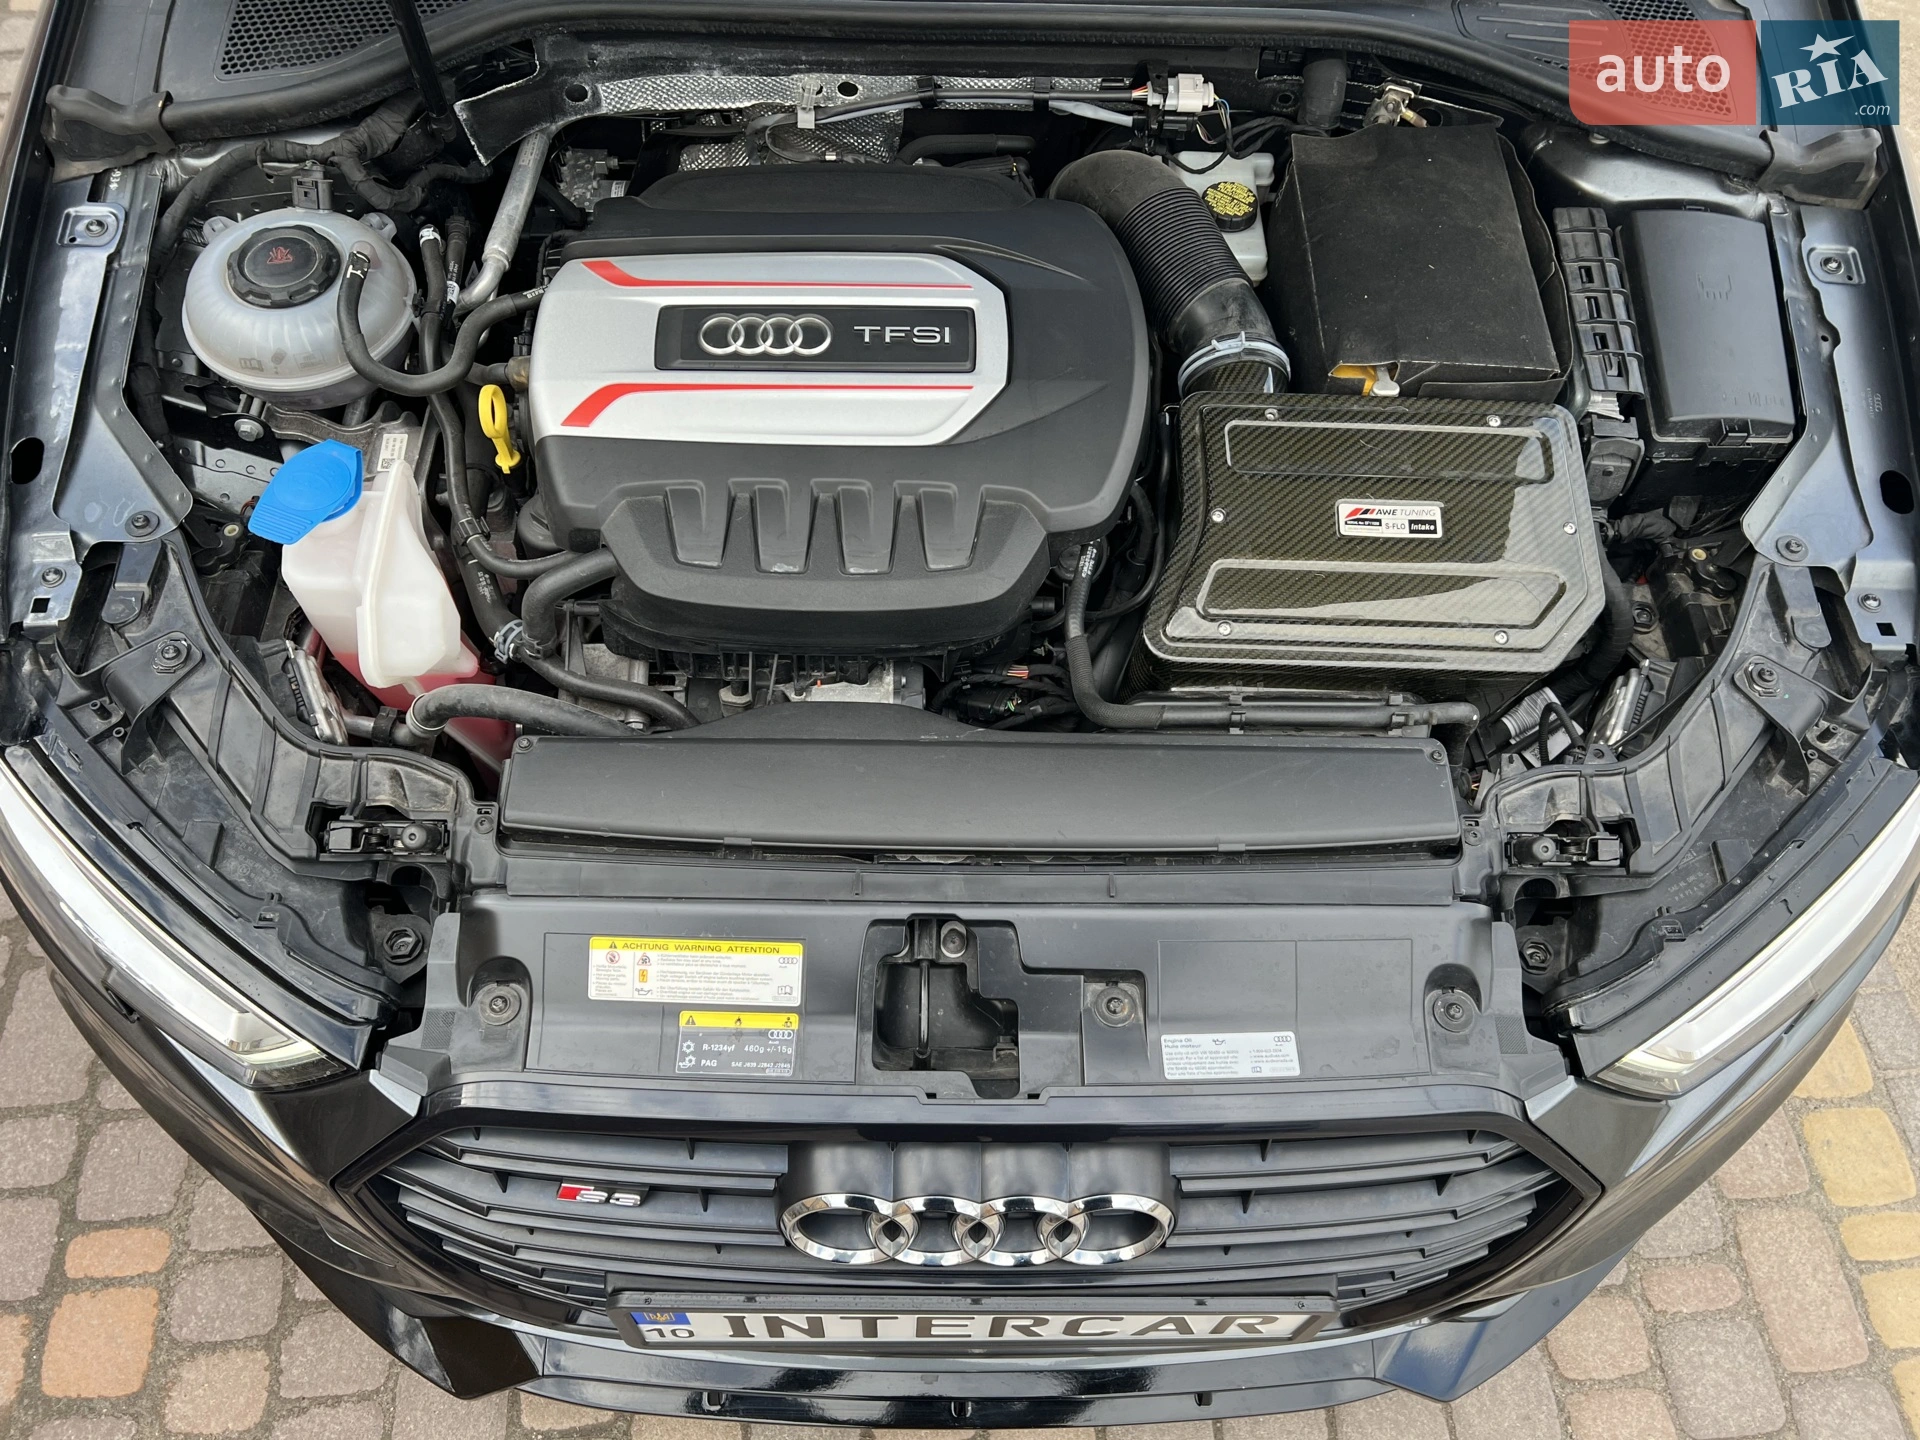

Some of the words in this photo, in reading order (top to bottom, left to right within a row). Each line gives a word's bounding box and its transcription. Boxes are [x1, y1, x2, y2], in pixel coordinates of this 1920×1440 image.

[853, 325, 951, 345] TFSI
[1375, 508, 1397, 516] AWE
[1400, 508, 1436, 517] TUNING
[1385, 522, 1406, 530] S-FLO
[1410, 521, 1435, 531] Intake
[622, 942, 669, 951] ACHTUNG
[674, 943, 722, 953] WARNING
[727, 945, 780, 954] ATTENTION
[702, 1043, 736, 1053] R-1234yf
[744, 1044, 765, 1054] 460g
[700, 1059, 718, 1067] PAG
[574, 1189, 641, 1208] S3
[644, 1327, 695, 1339] 10
[722, 1315, 1280, 1339] INTERCAR
